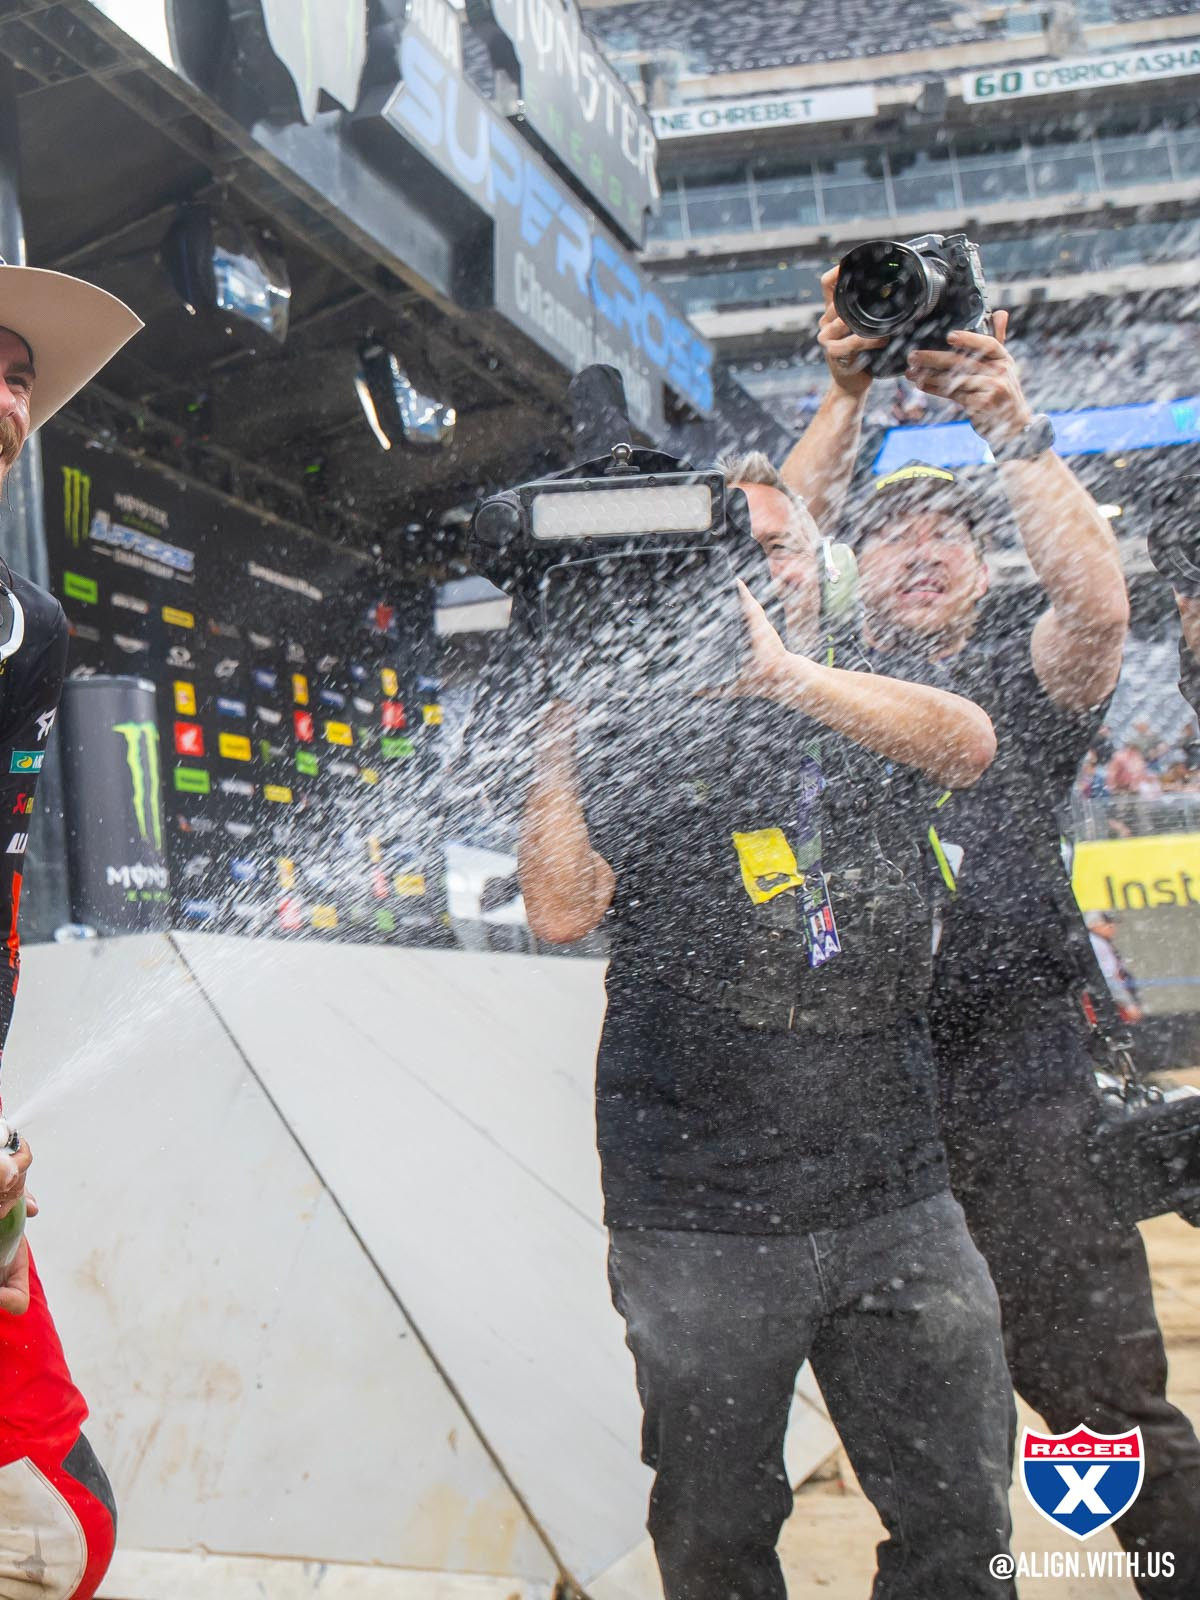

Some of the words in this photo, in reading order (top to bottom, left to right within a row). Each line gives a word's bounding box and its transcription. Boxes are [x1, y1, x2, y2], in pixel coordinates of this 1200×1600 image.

[975, 71, 1022, 96] 60
[699, 98, 814, 127] CHREBET
[398, 34, 714, 412] SUPERCROSS
